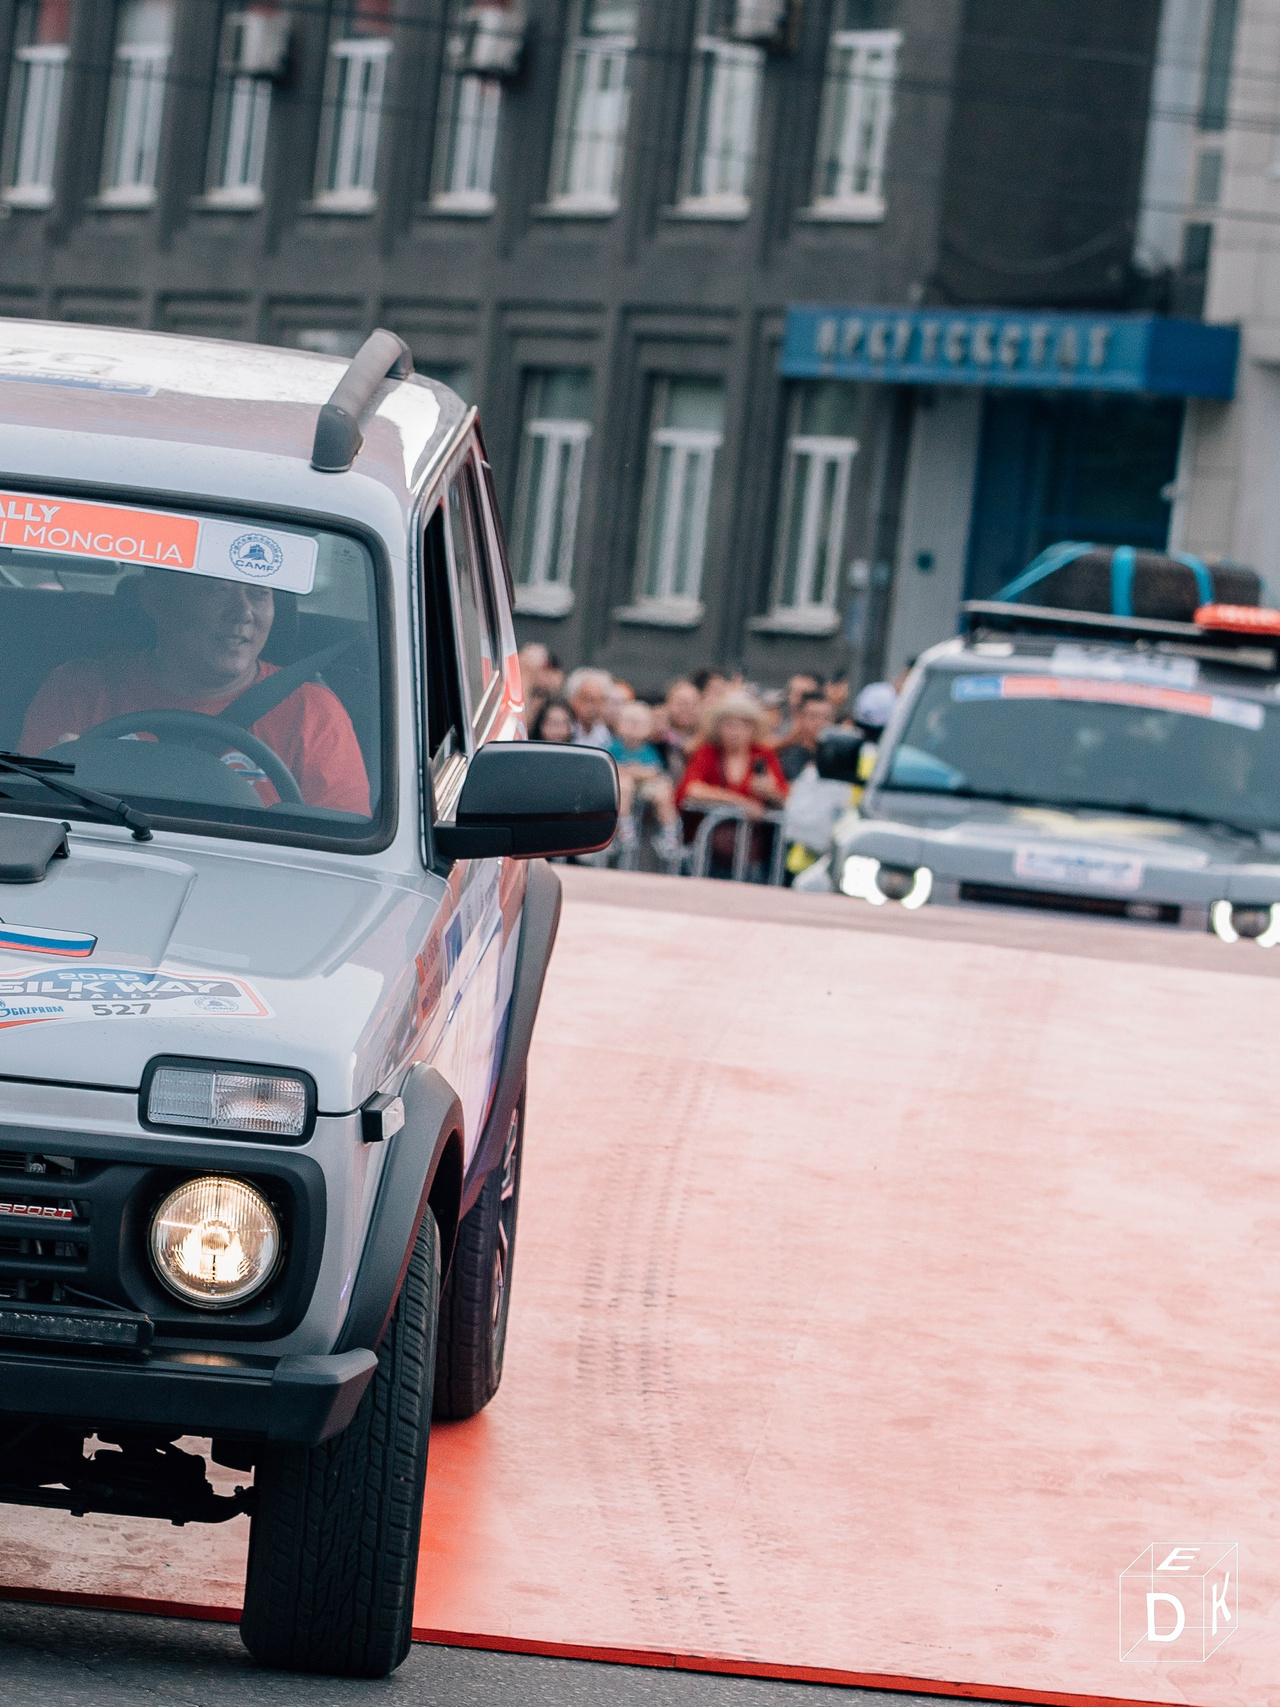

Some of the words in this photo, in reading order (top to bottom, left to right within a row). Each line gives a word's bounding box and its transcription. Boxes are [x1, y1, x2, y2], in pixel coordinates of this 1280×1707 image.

[23, 524, 184, 564] MONGOLIA
[235, 559, 274, 572] CAMF
[56, 972, 140, 981] 2025
[121, 981, 223, 994] WAY
[67, 992, 161, 1000] RALLY
[11, 1005, 65, 1016] GAZPROM
[92, 1003, 152, 1016] 527
